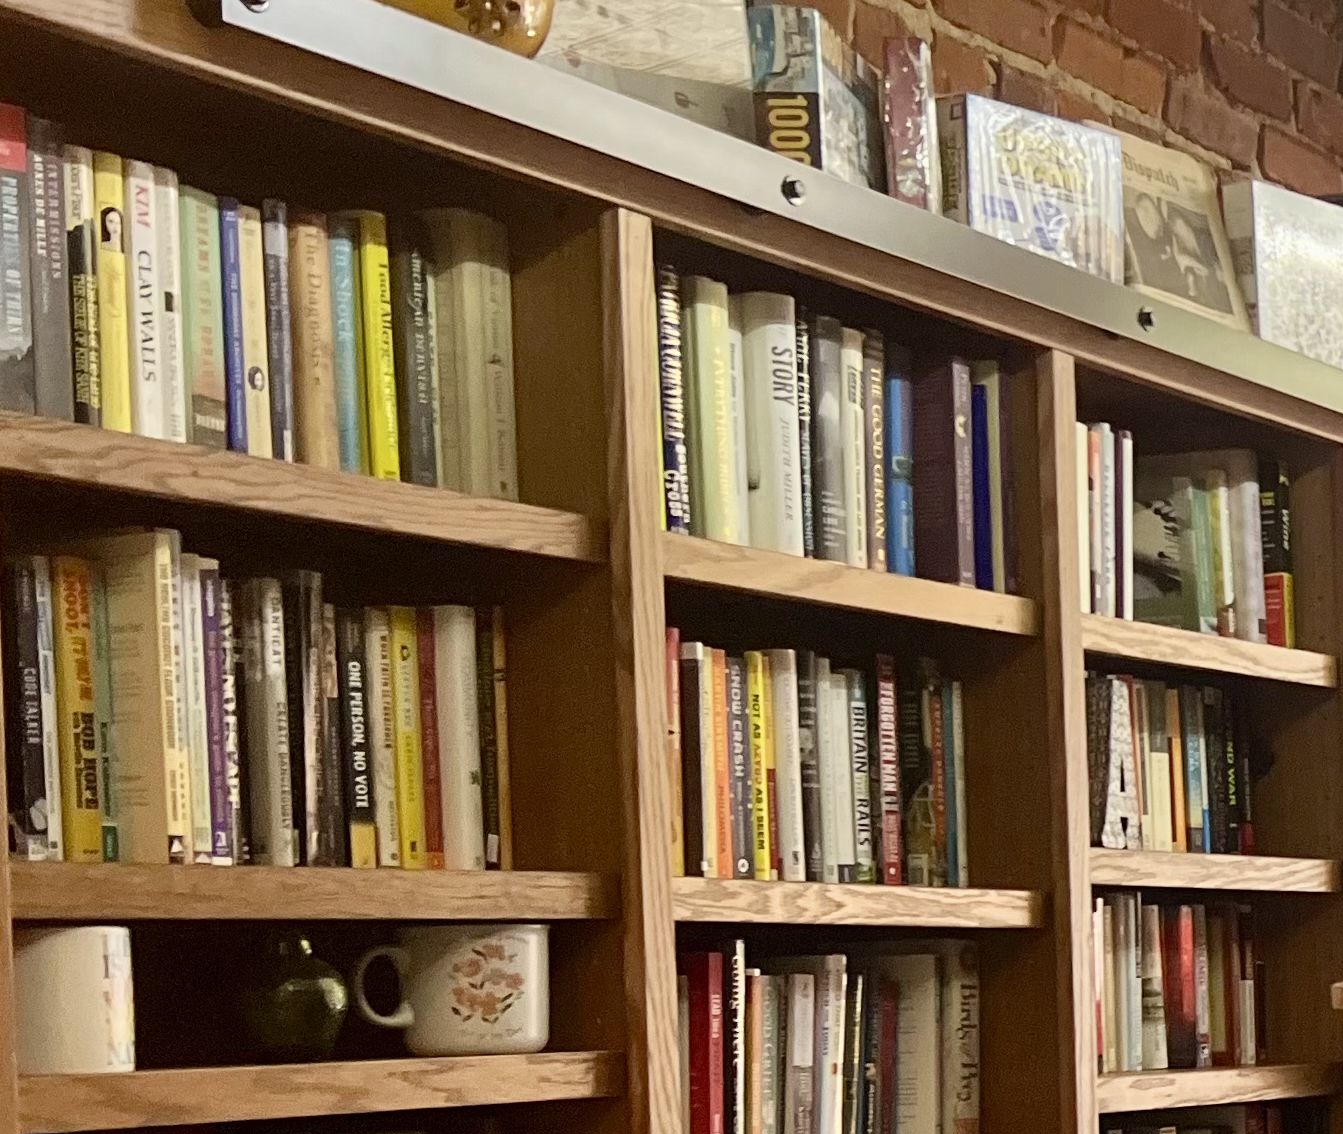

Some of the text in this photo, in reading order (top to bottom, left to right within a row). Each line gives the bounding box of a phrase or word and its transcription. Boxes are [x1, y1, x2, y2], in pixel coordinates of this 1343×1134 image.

[136, 185, 156, 383] KIM CLAY WALLS
[335, 244, 354, 341] In Shock
[772, 344, 795, 522] STORY JUDITH MILLER
[870, 367, 886, 539] THE GOOD GERMAN
[1281, 508, 1291, 551] Wine
[24, 667, 38, 697] CODE
[731, 665, 745, 777] SNOW CRASH
[752, 693, 760, 718] NOT
[82, 711, 100, 810] BOB HOPE
[348, 661, 370, 808] ONE PERSON, NO VOTE
[753, 723, 761, 739] AS
[852, 706, 872, 847] BRITAIN RAILS
[880, 690, 898, 792] FORGOTTEN MAN
[755, 788, 764, 804] AS
[757, 815, 765, 851] SEEM
[1228, 767, 1237, 806] WAR
[956, 984, 979, 1036] Birds
